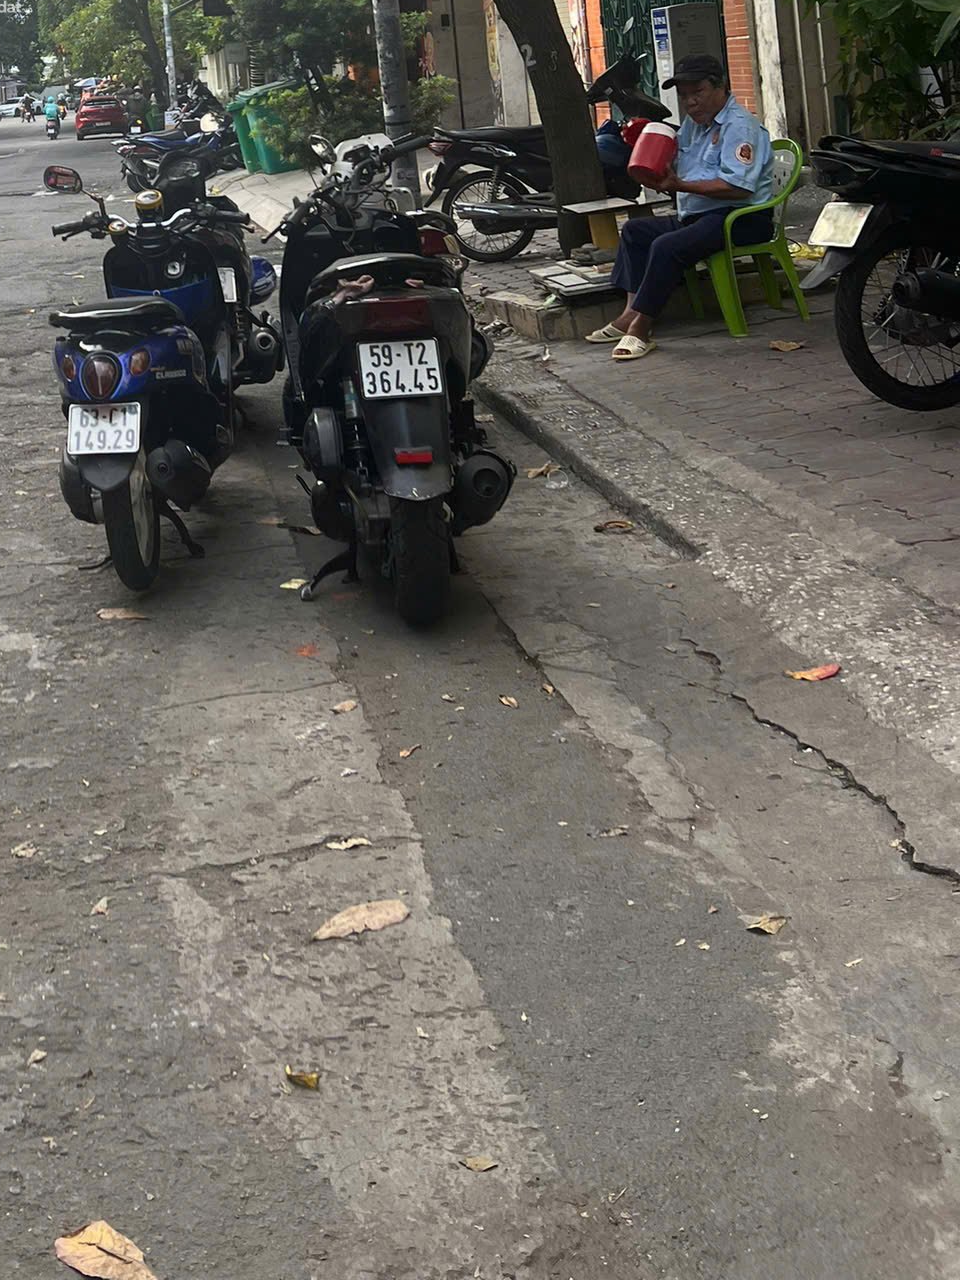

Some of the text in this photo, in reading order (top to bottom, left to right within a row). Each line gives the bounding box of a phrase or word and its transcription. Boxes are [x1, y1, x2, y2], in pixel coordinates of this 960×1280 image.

[369, 342, 428, 368] 59-T2
[365, 367, 439, 395] 364.45
[79, 407, 128, 428] 63-C1
[74, 429, 136, 452] 149.29
